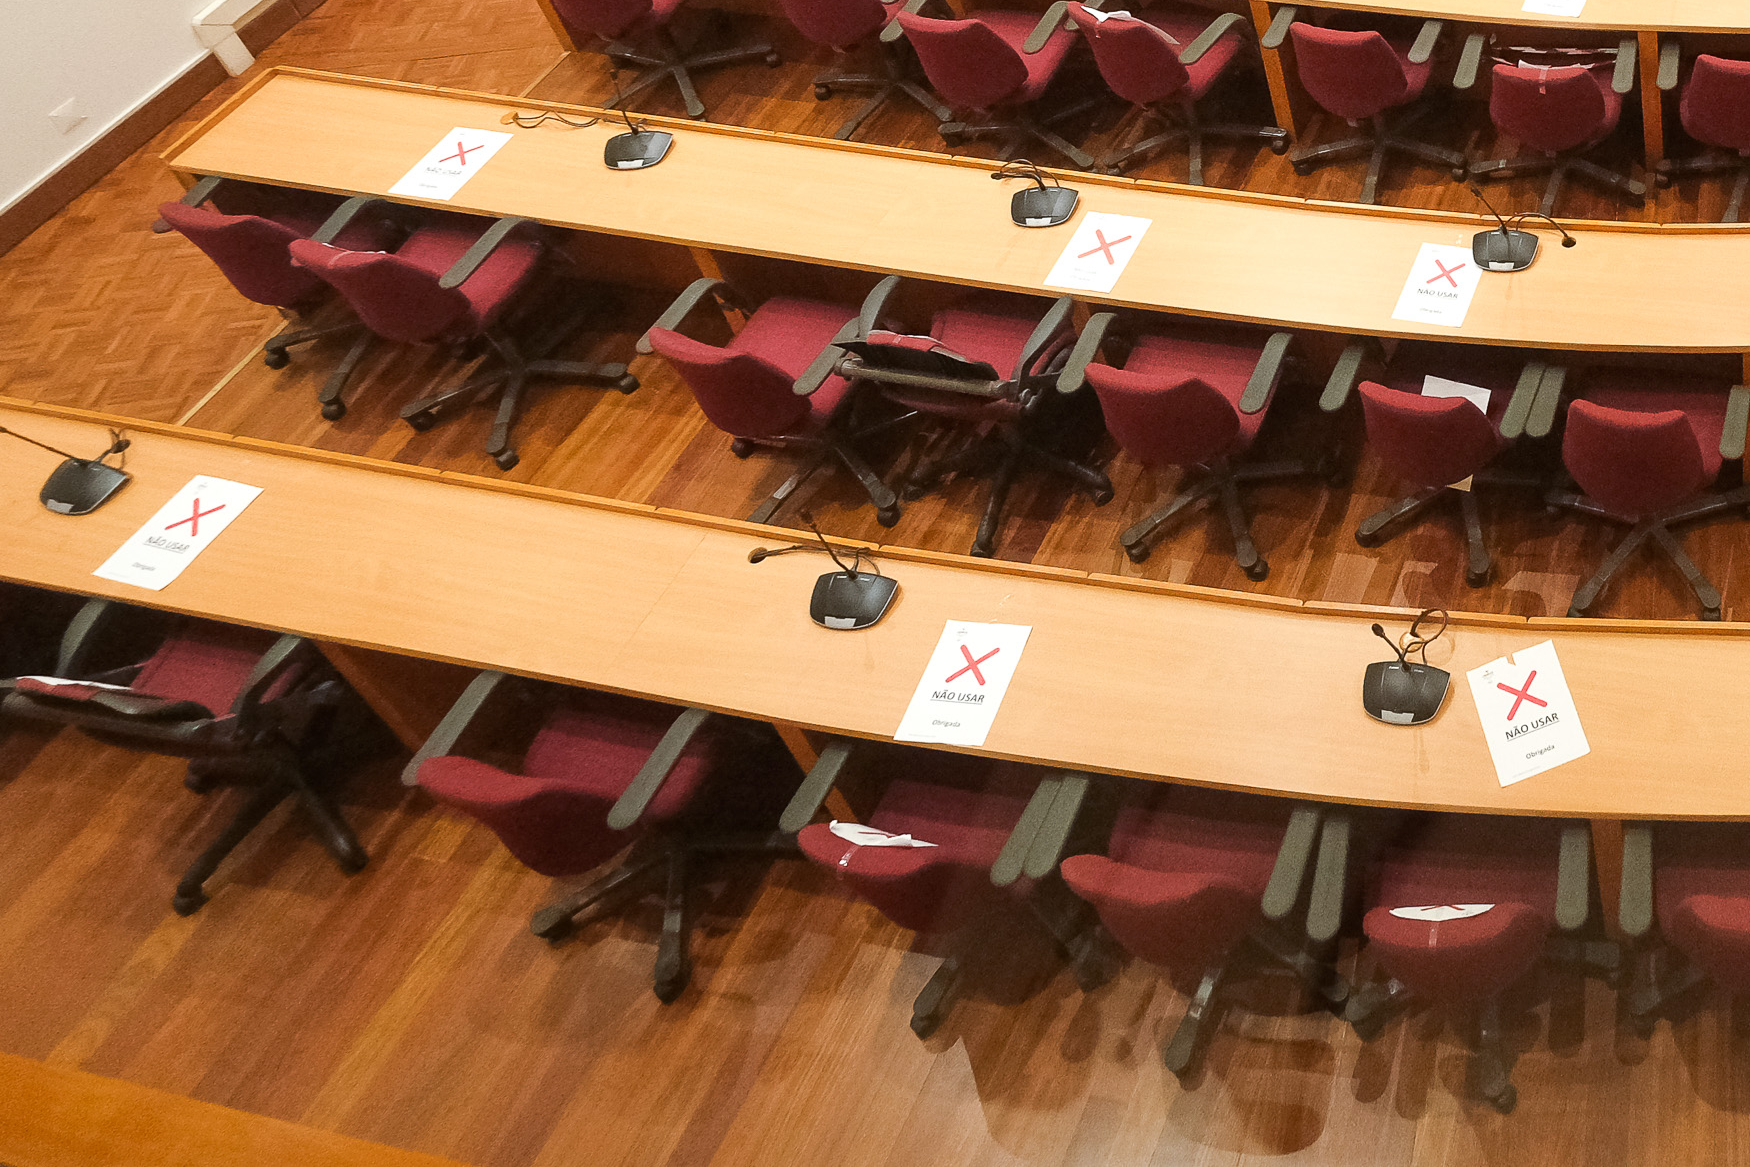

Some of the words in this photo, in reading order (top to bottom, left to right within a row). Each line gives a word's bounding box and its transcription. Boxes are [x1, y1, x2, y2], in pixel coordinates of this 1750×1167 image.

[932, 689, 955, 701] NÃO
[957, 693, 985, 704] USAR
[1505, 724, 1529, 740] NÃO
[1530, 712, 1559, 729] USAR
[1526, 744, 1555, 760] Obrigada
